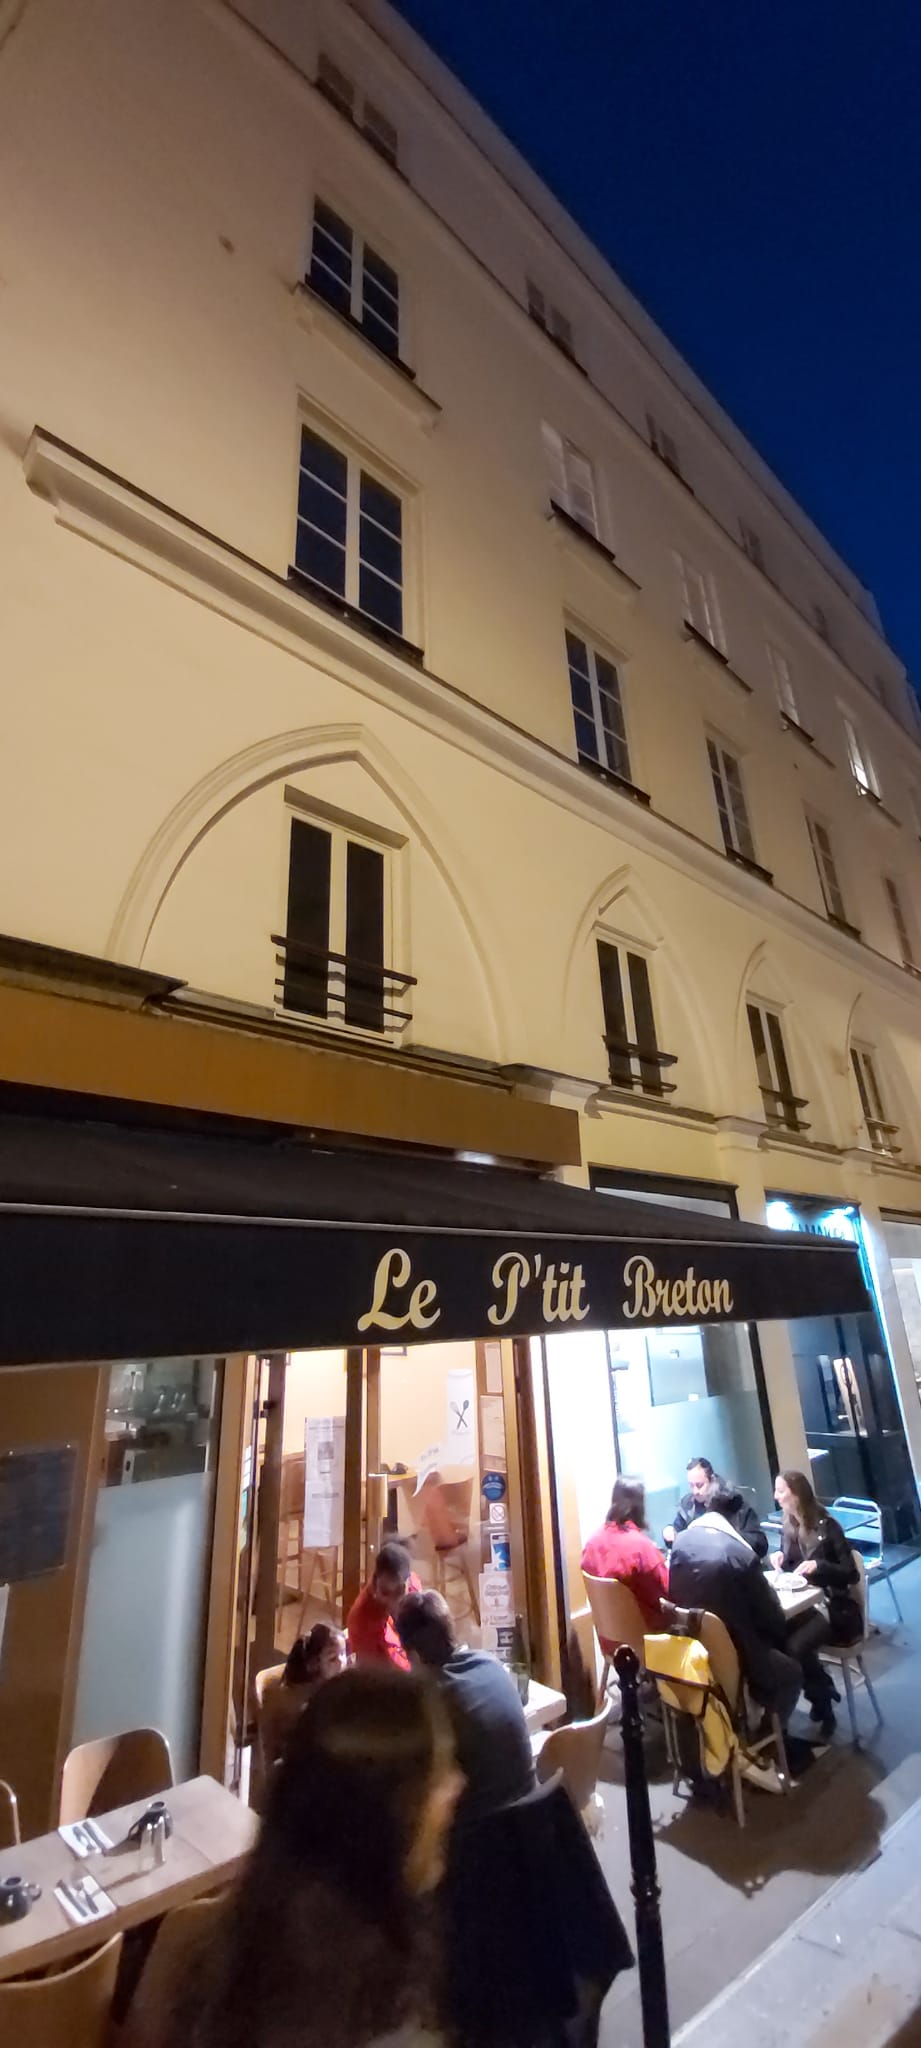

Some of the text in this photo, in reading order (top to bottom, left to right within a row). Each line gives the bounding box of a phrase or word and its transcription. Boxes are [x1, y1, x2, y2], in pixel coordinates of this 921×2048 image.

[357, 1248, 734, 1332] Le P'tit Breton
